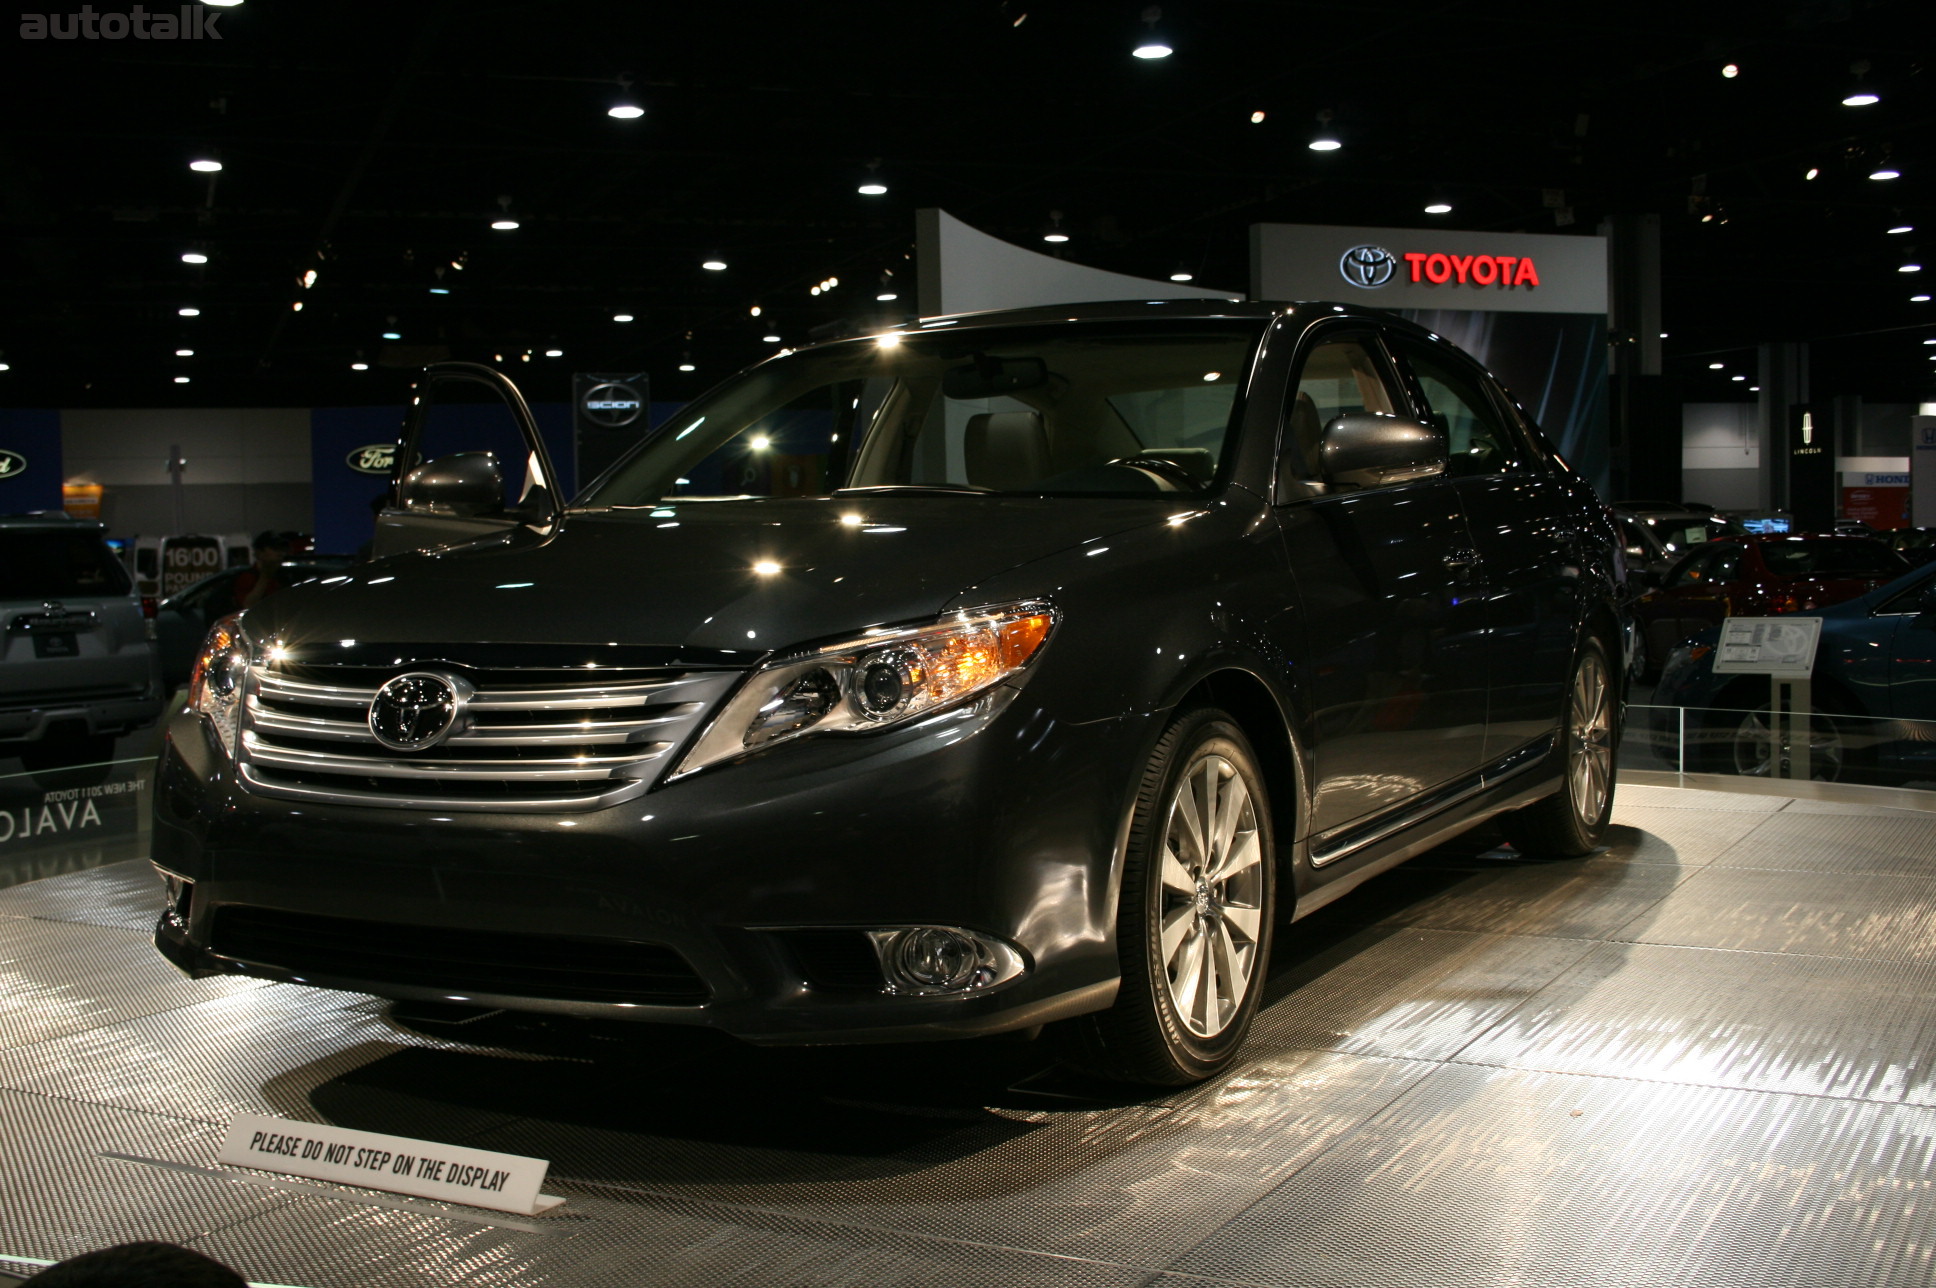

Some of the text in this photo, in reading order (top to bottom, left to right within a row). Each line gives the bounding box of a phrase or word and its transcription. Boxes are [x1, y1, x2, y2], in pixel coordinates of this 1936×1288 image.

[1404, 252, 1540, 287] TOYOTA
[359, 448, 396, 469] For
[1875, 475, 1910, 484] HOND
[165, 547, 219, 566] 1600
[249, 1131, 511, 1192] PLEASE DO NOT STEP ON THE DISPLAY
